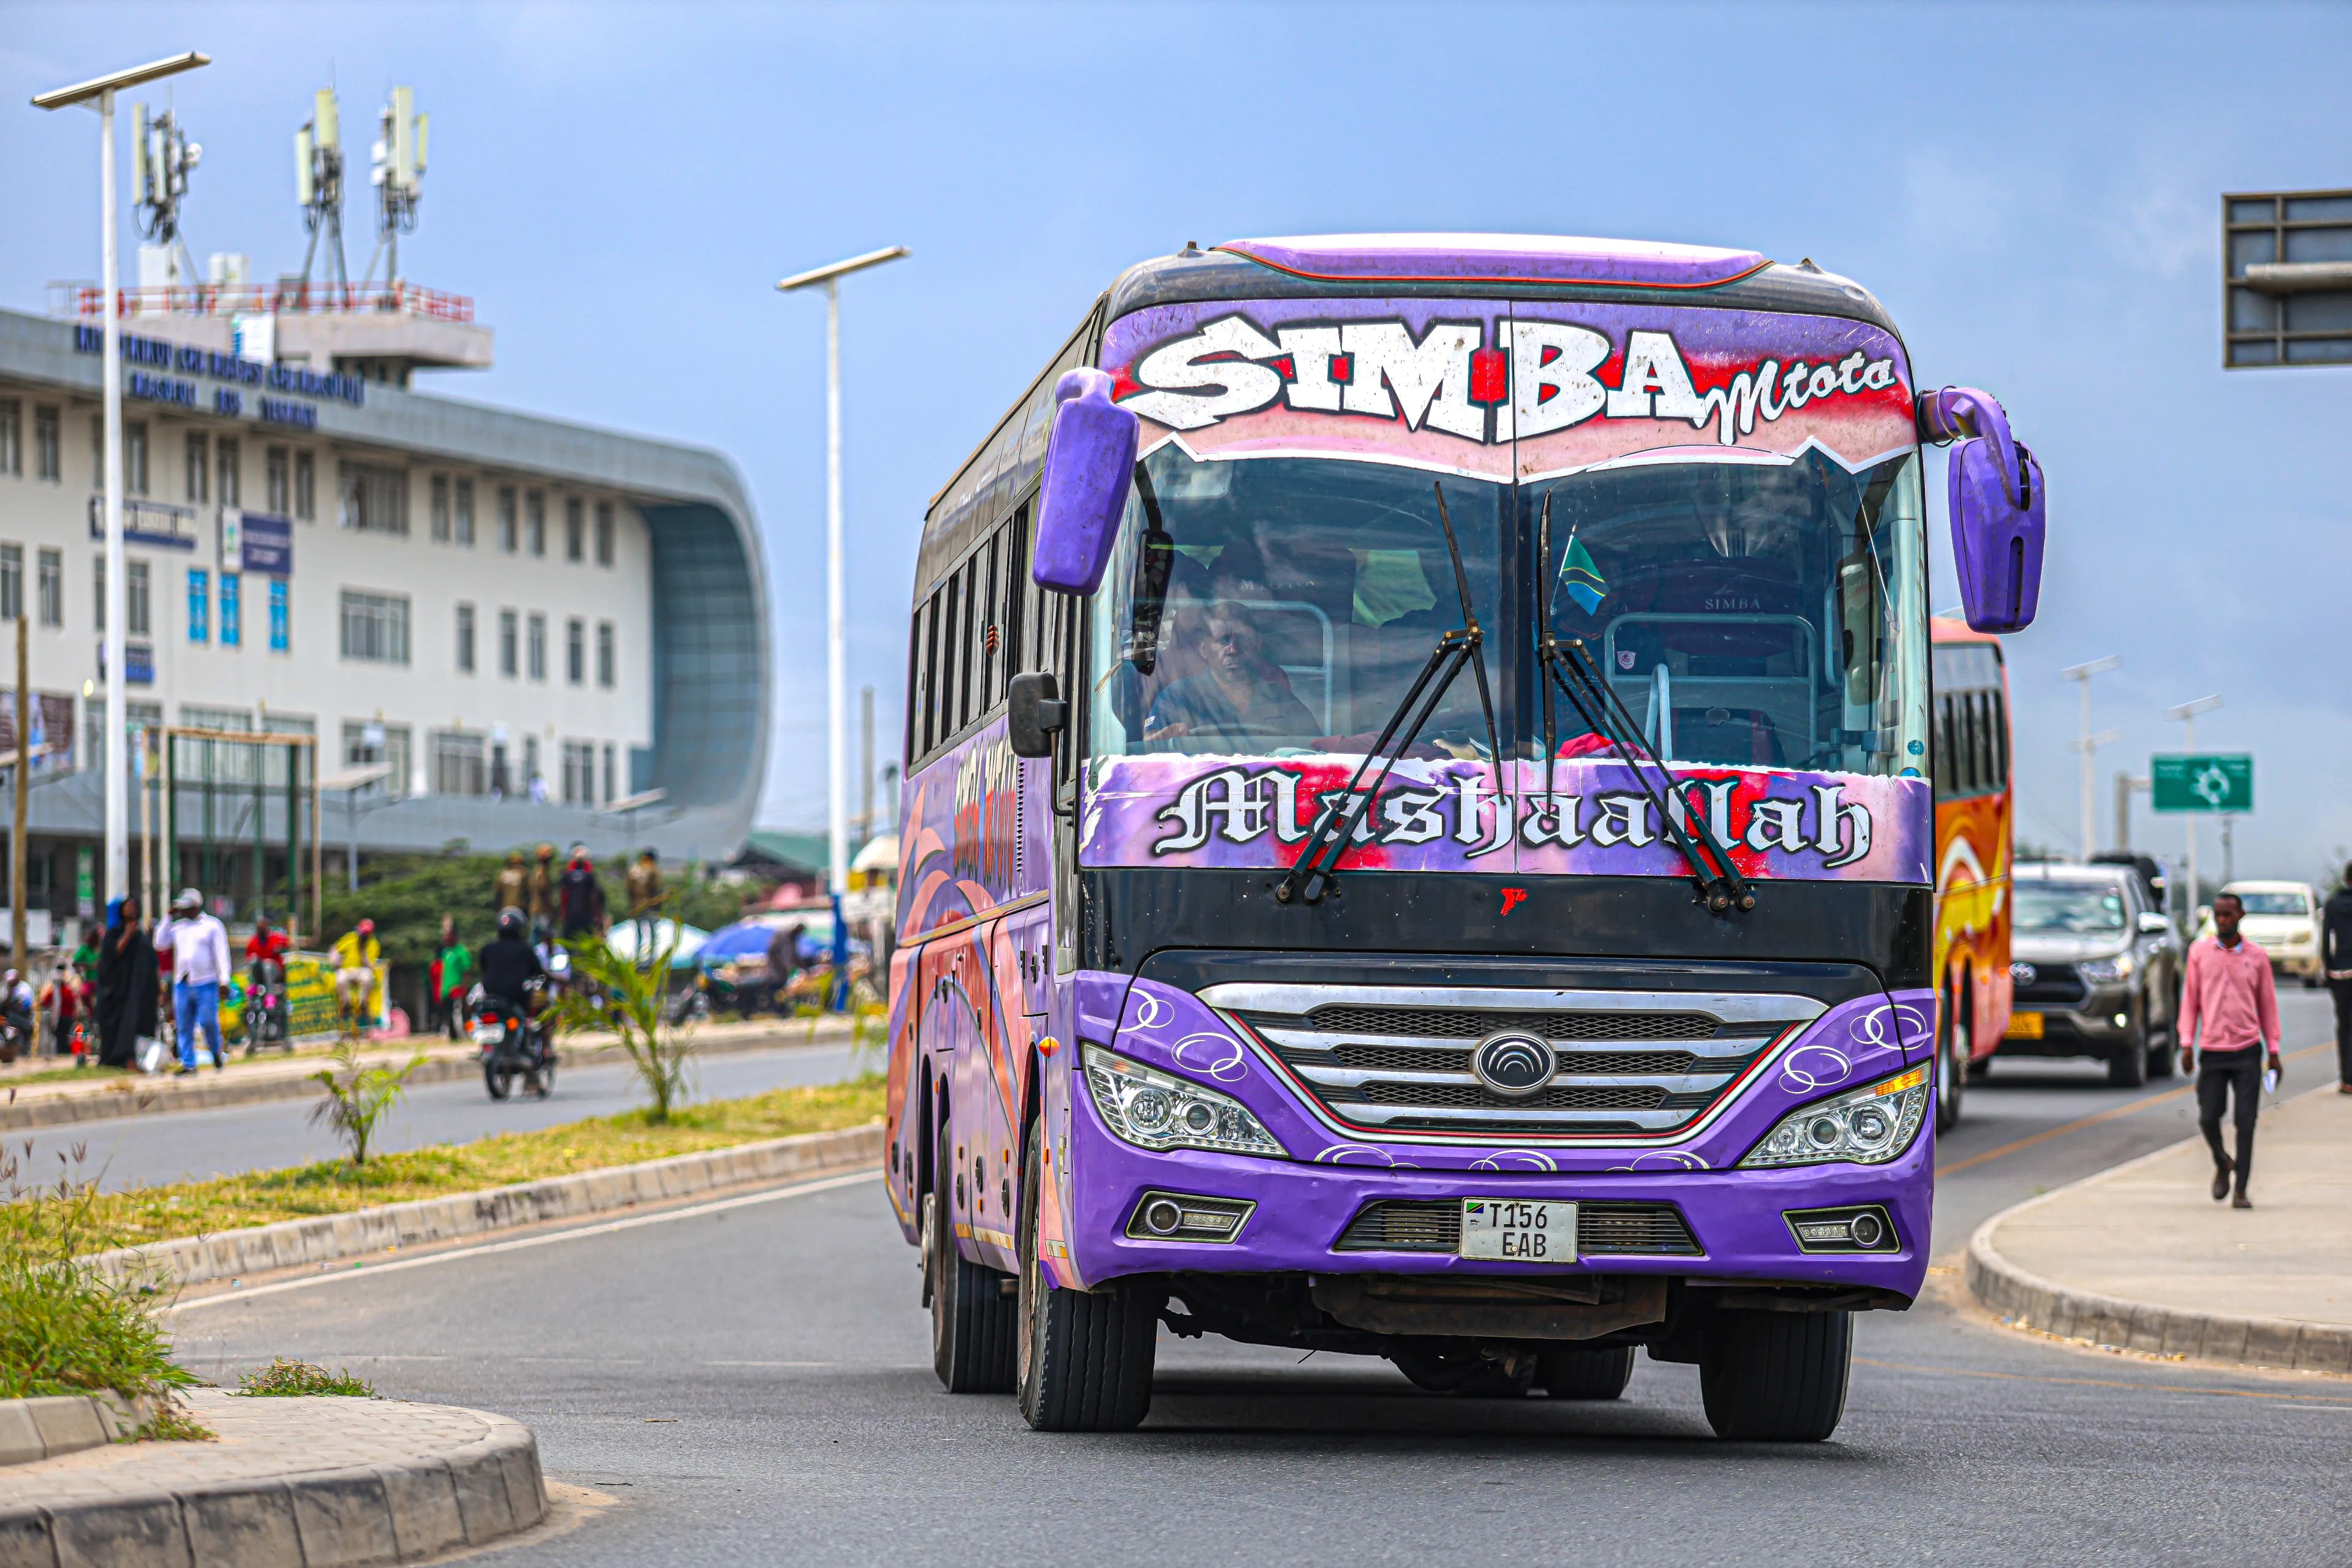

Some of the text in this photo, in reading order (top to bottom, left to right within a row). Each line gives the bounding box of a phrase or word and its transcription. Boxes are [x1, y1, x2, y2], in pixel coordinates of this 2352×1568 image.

[1115, 315, 1896, 446] SIMBA Mtoto
[1705, 598, 1761, 610] SIMBA
[1489, 1203, 1548, 1229] T156
[1502, 1232, 1547, 1257] EAB
